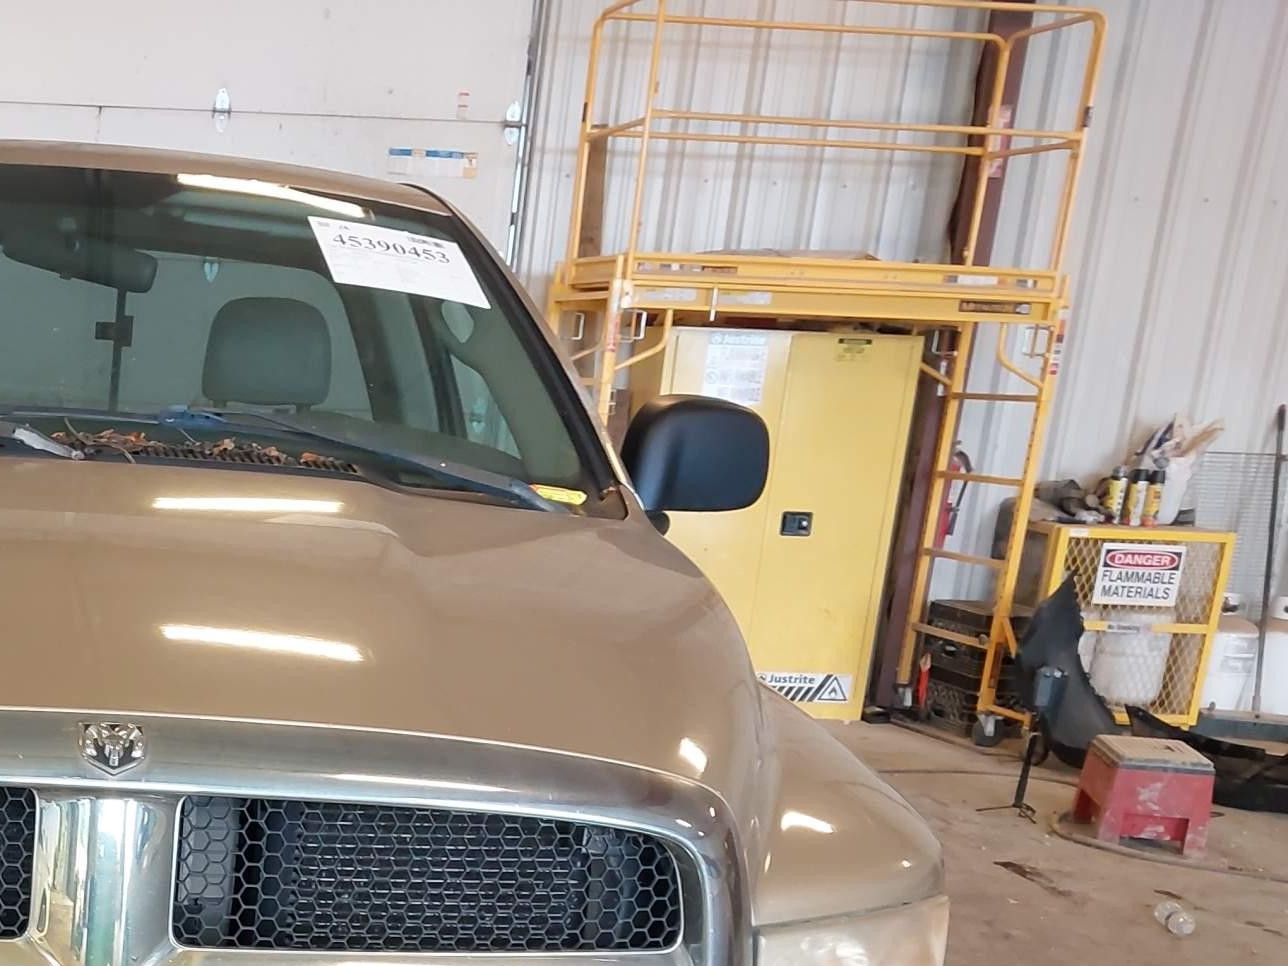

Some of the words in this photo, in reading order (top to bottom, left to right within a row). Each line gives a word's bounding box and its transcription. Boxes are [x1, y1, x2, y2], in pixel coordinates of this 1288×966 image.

[333, 233, 450, 264] 45390453
[1114, 553, 1171, 566] DANGER
[1101, 569, 1177, 585] FLAMMABLE
[1100, 585, 1171, 600] MATERIALS
[768, 674, 816, 685] Justrite
